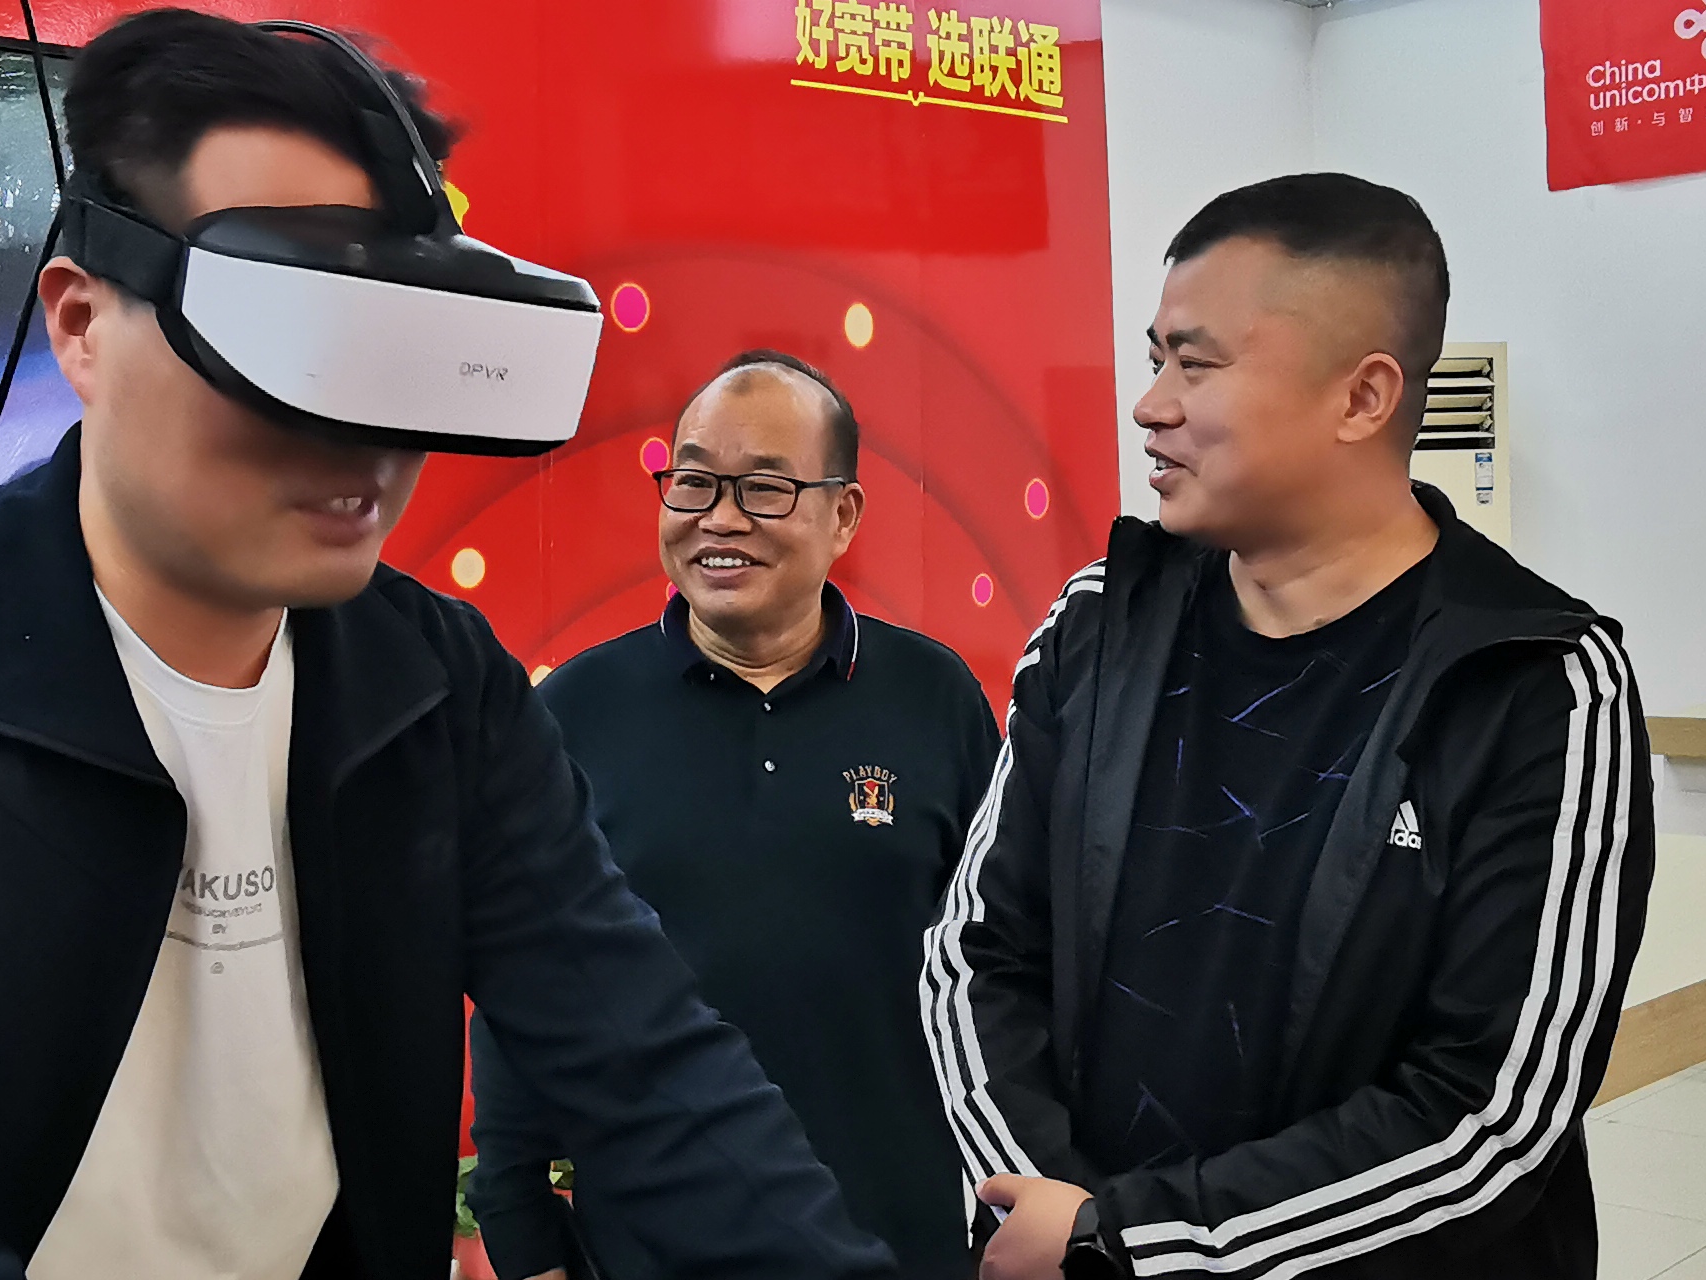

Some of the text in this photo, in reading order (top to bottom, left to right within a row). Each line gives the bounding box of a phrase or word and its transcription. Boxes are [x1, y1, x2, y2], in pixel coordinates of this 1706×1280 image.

[926, 7, 1064, 109] 选联通
[1586, 59, 1661, 88] China
[842, 765, 898, 785] PLAYBOY
